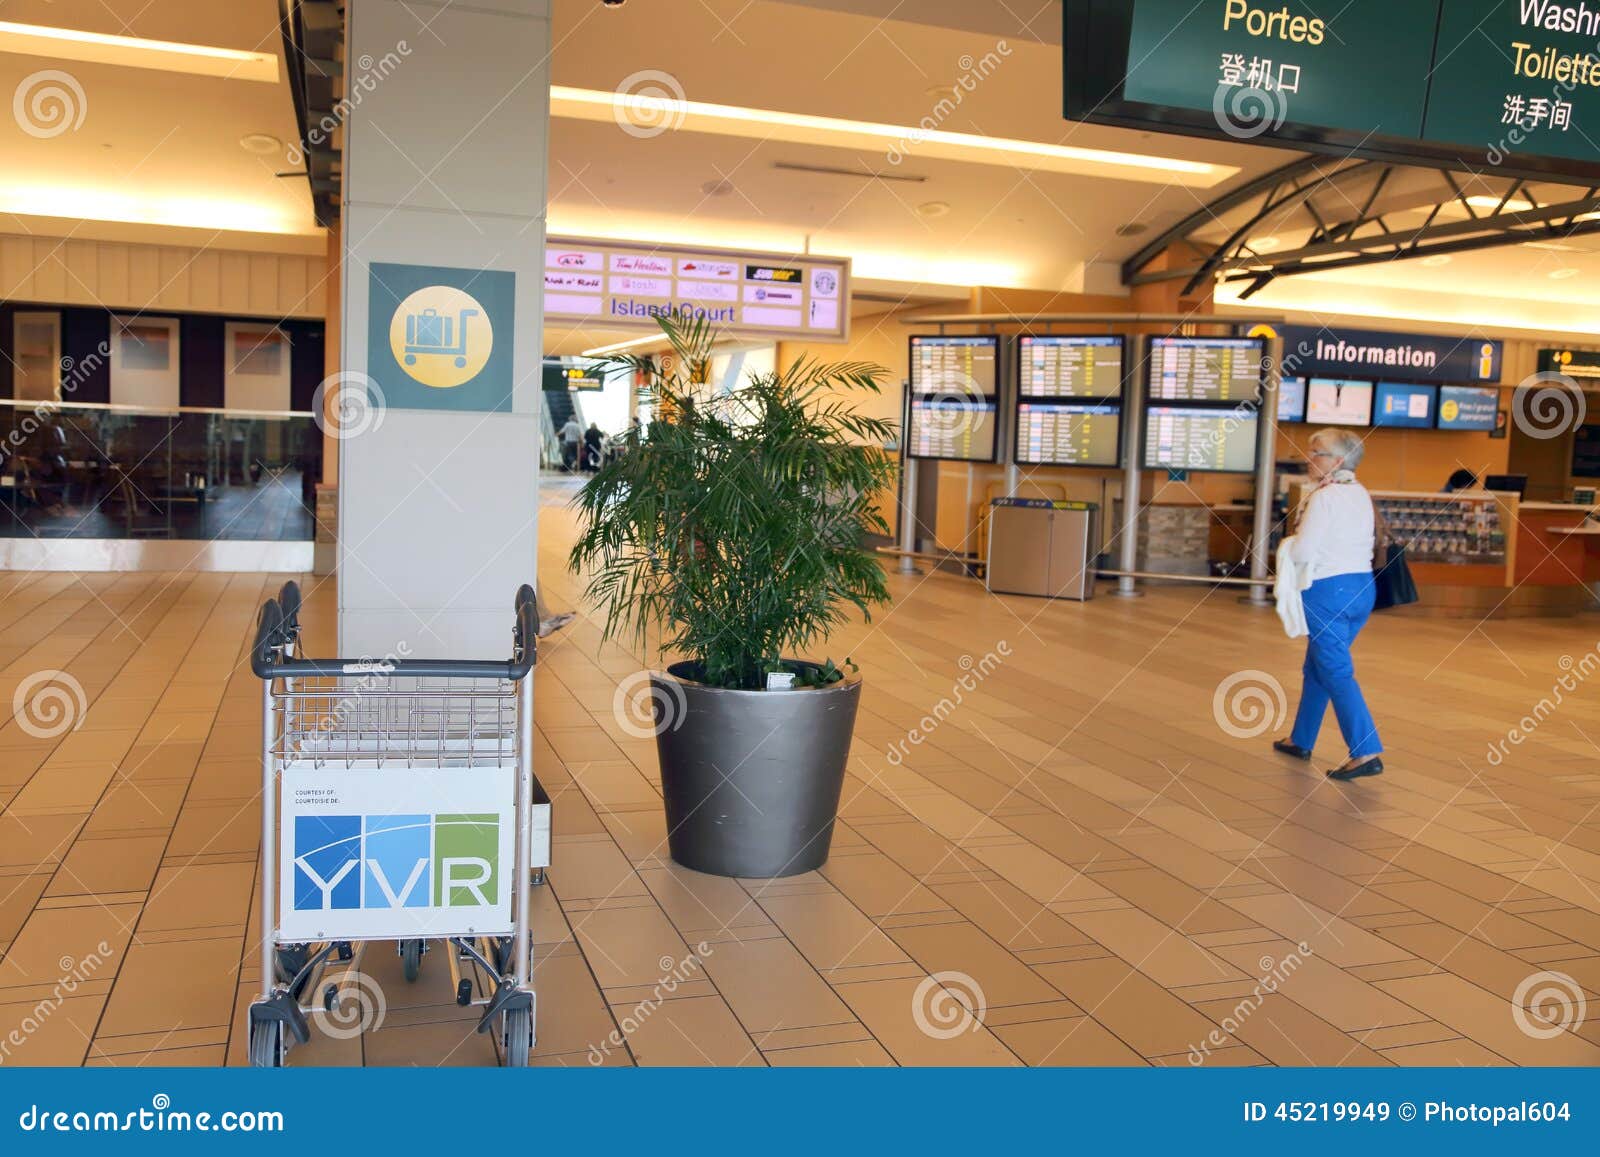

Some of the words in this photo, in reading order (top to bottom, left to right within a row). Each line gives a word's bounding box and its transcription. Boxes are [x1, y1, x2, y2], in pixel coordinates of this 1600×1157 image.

[1223, 0, 1325, 45] Portes
[1218, 52, 1301, 94] 登机口
[1501, 94, 1573, 131] 洗手间
[611, 298, 672, 318] Island
[679, 302, 735, 322] Court
[1316, 339, 1437, 368] Information
[294, 856, 492, 910] YVR
